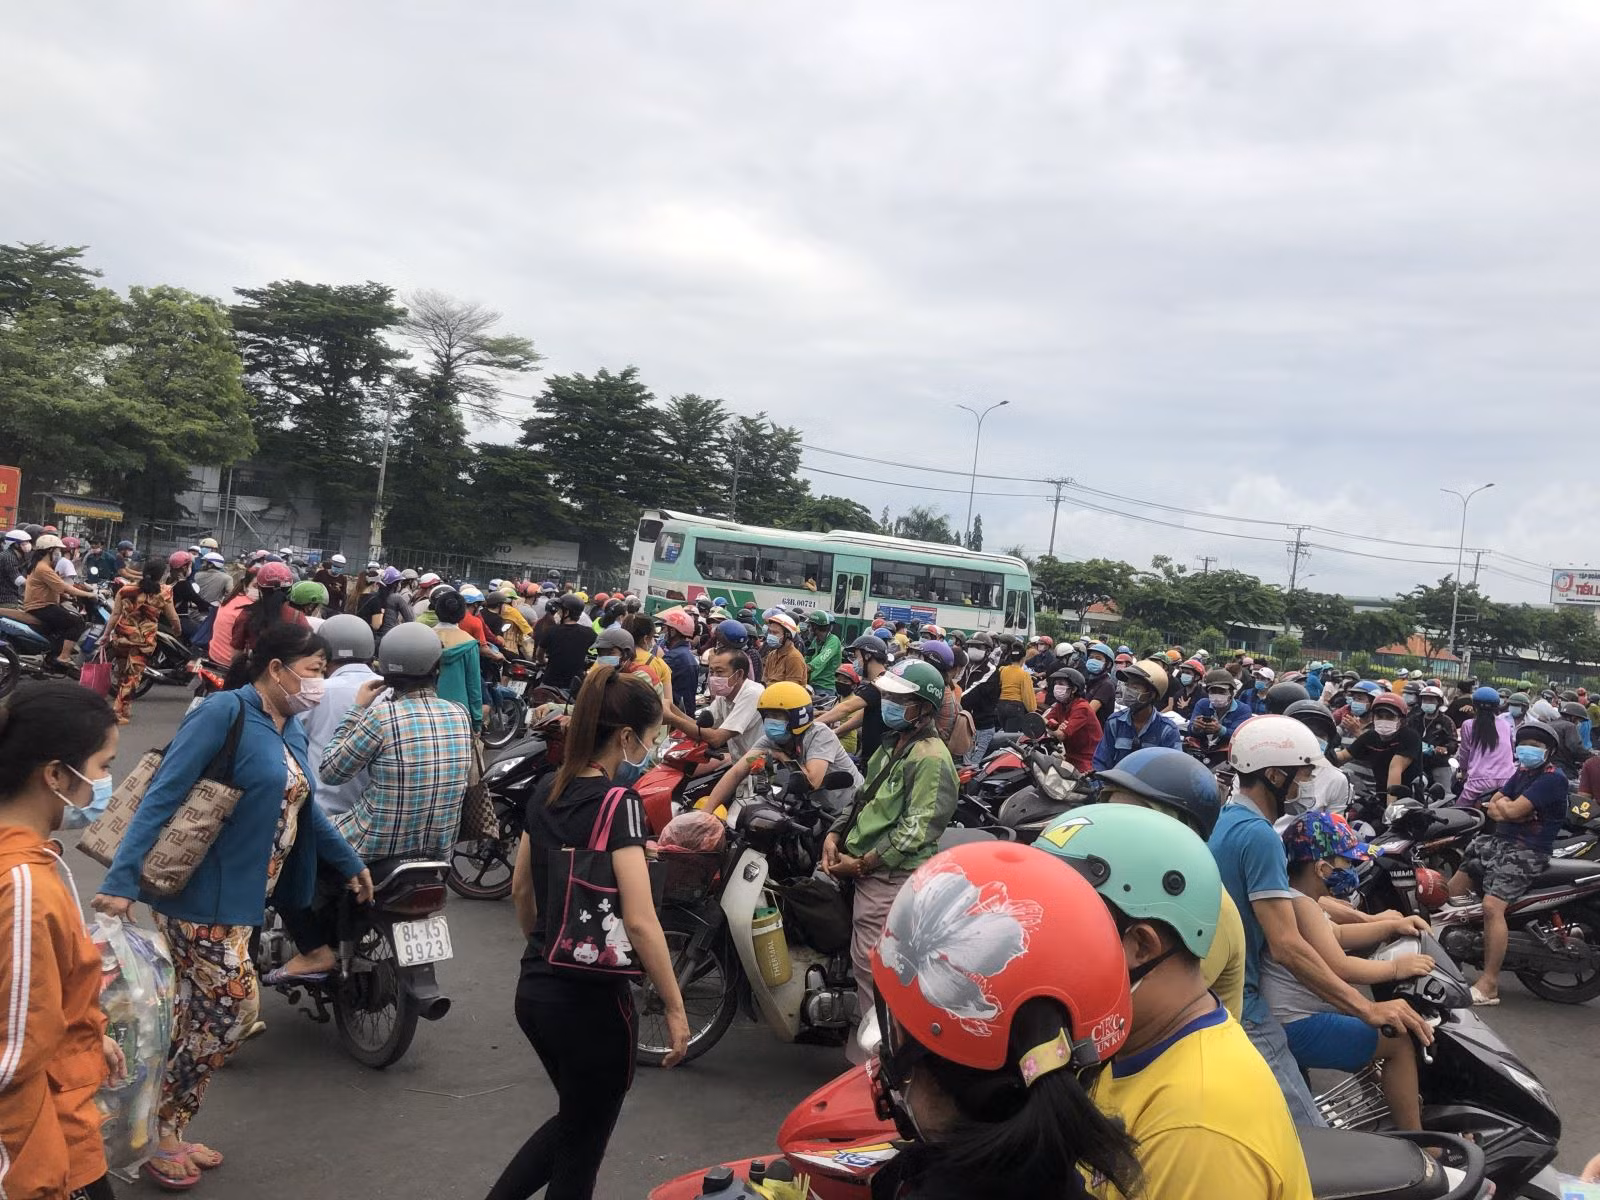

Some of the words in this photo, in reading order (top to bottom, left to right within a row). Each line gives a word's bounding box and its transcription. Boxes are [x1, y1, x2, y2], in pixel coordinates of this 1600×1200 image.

[782, 597, 816, 608] 63B.00721
[1390, 870, 1413, 878] YAMAHA
[405, 940, 444, 961] 9923
[768, 940, 781, 977] THERMAL
